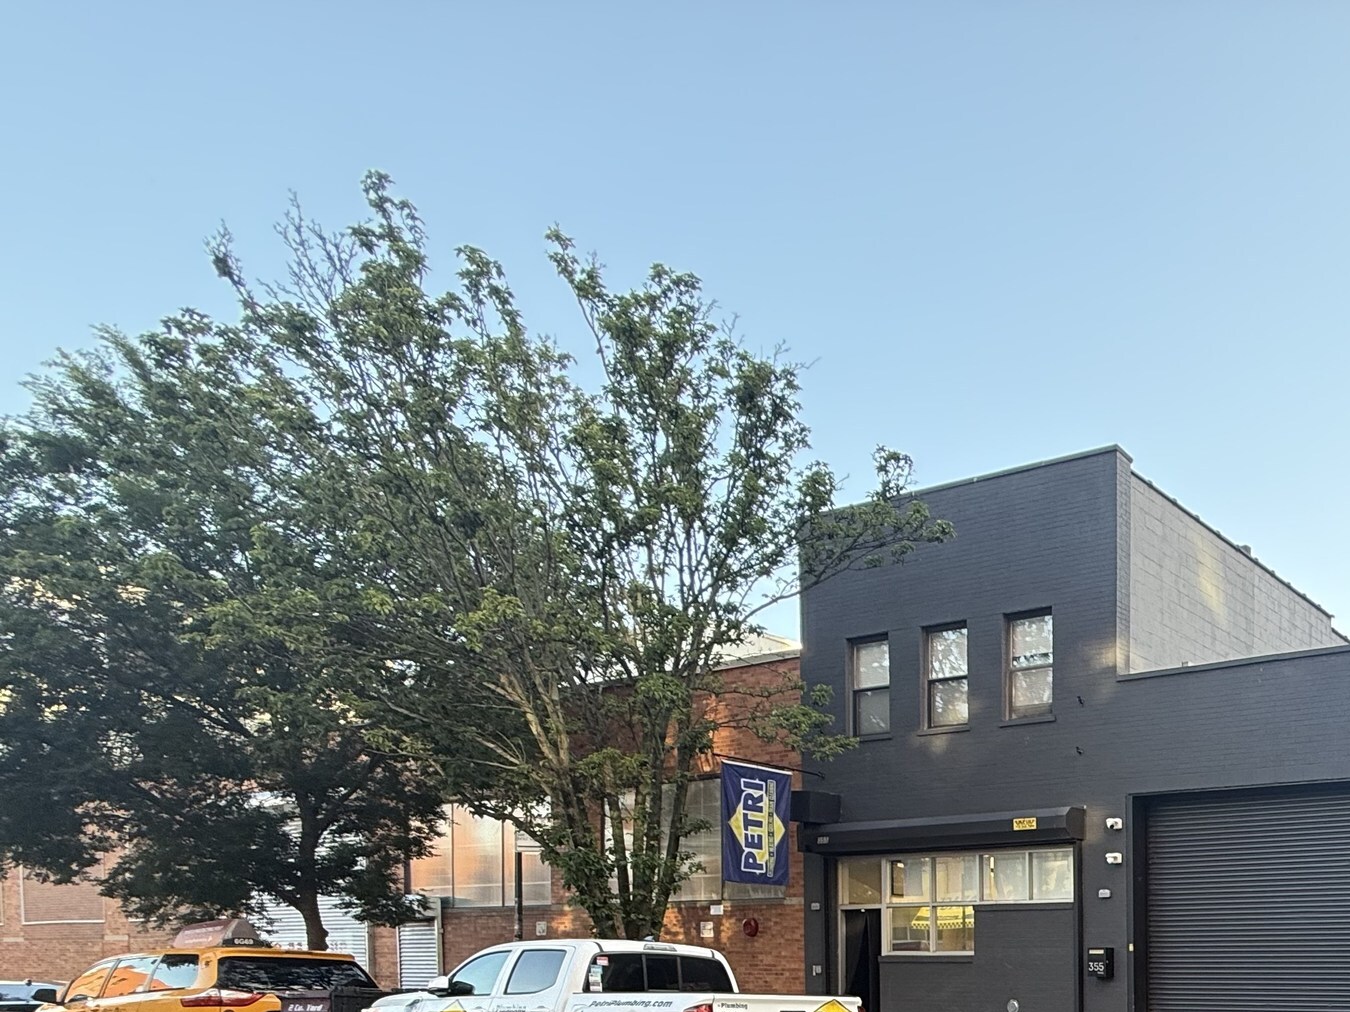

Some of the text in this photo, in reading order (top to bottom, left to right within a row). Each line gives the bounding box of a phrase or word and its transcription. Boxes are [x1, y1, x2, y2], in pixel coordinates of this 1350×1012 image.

[742, 778, 765, 872] PETRI
[1088, 961, 1104, 971] 355
[720, 1002, 748, 1010] Plumbing
